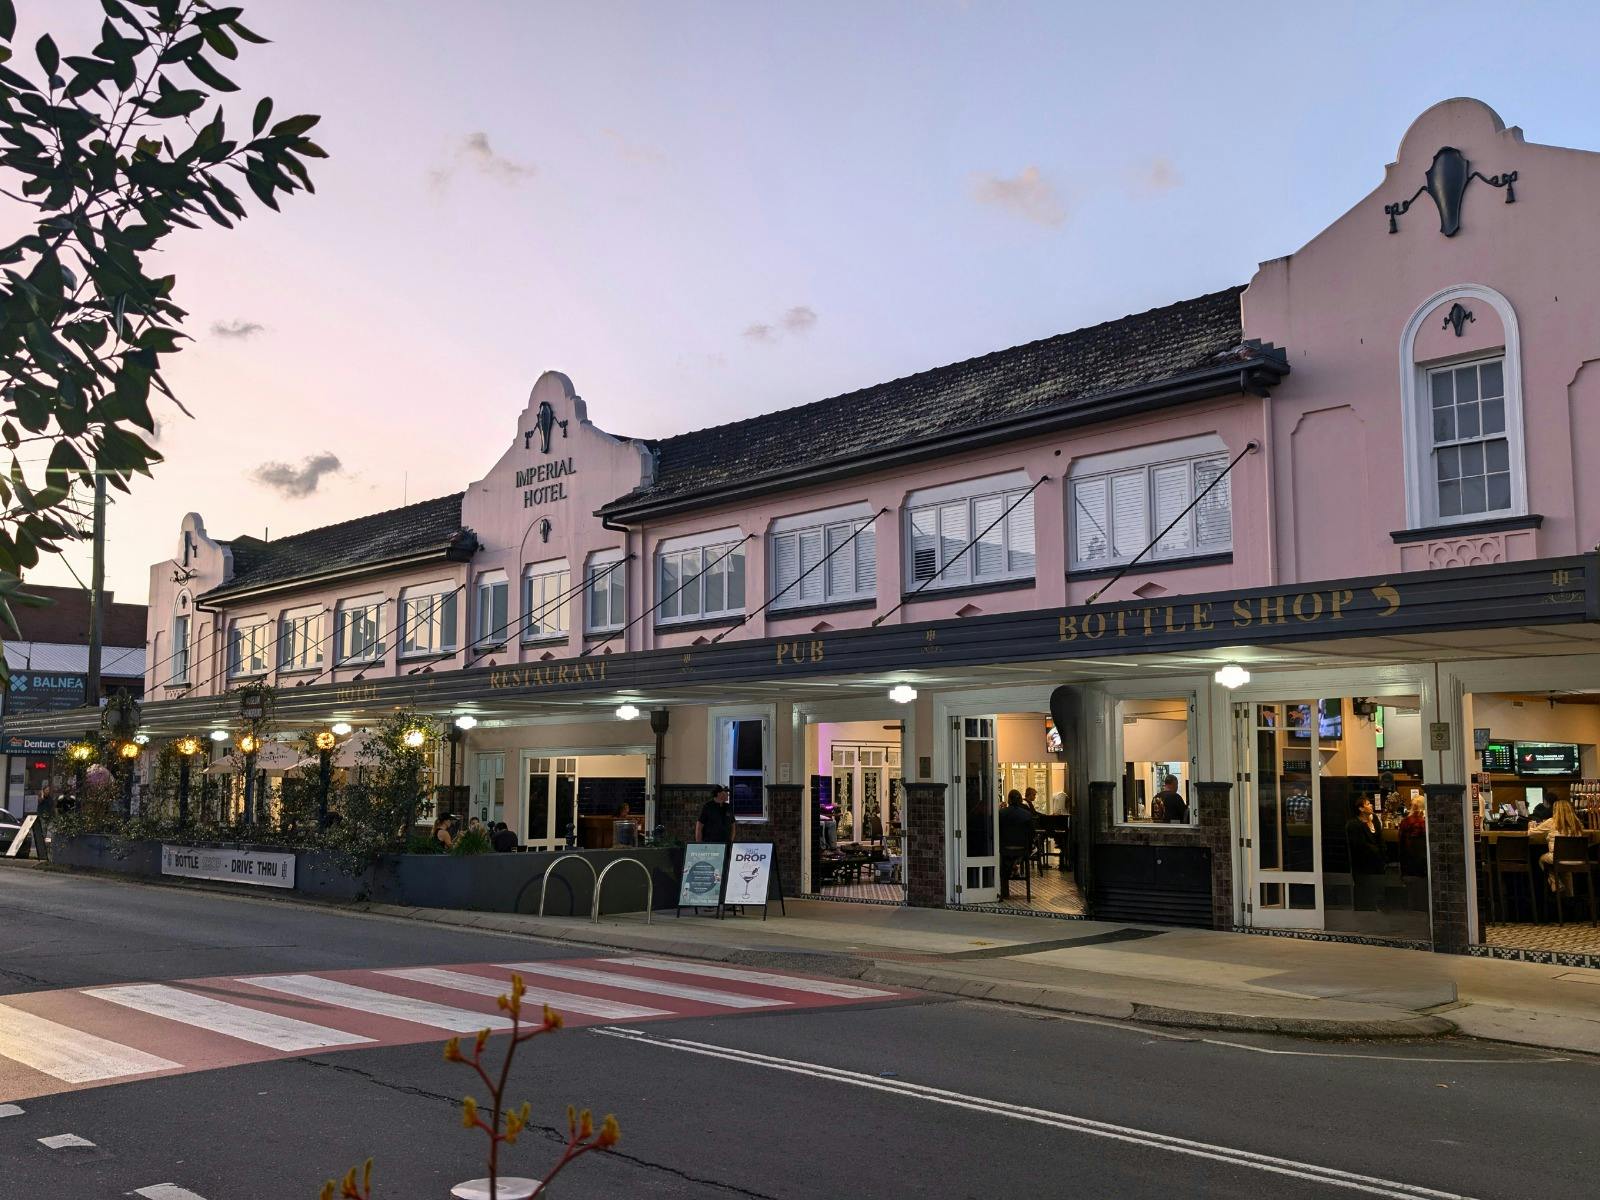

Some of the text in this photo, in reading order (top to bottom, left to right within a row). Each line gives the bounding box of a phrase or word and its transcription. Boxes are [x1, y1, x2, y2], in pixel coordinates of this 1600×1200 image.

[516, 457, 576, 488] IMPERIAL
[524, 482, 567, 508] HOTEL
[1058, 589, 1354, 642] BOTTLE SHOP
[775, 640, 824, 665] PUB
[33, 677, 83, 688] BALNEA
[490, 660, 608, 689] RESTAURANT
[336, 684, 379, 702] HOTEL
[24, 739, 55, 749] Denture
[175, 854, 199, 869] BOTTLE
[231, 859, 254, 875] DRIVE
[257, 861, 278, 877] THRU
